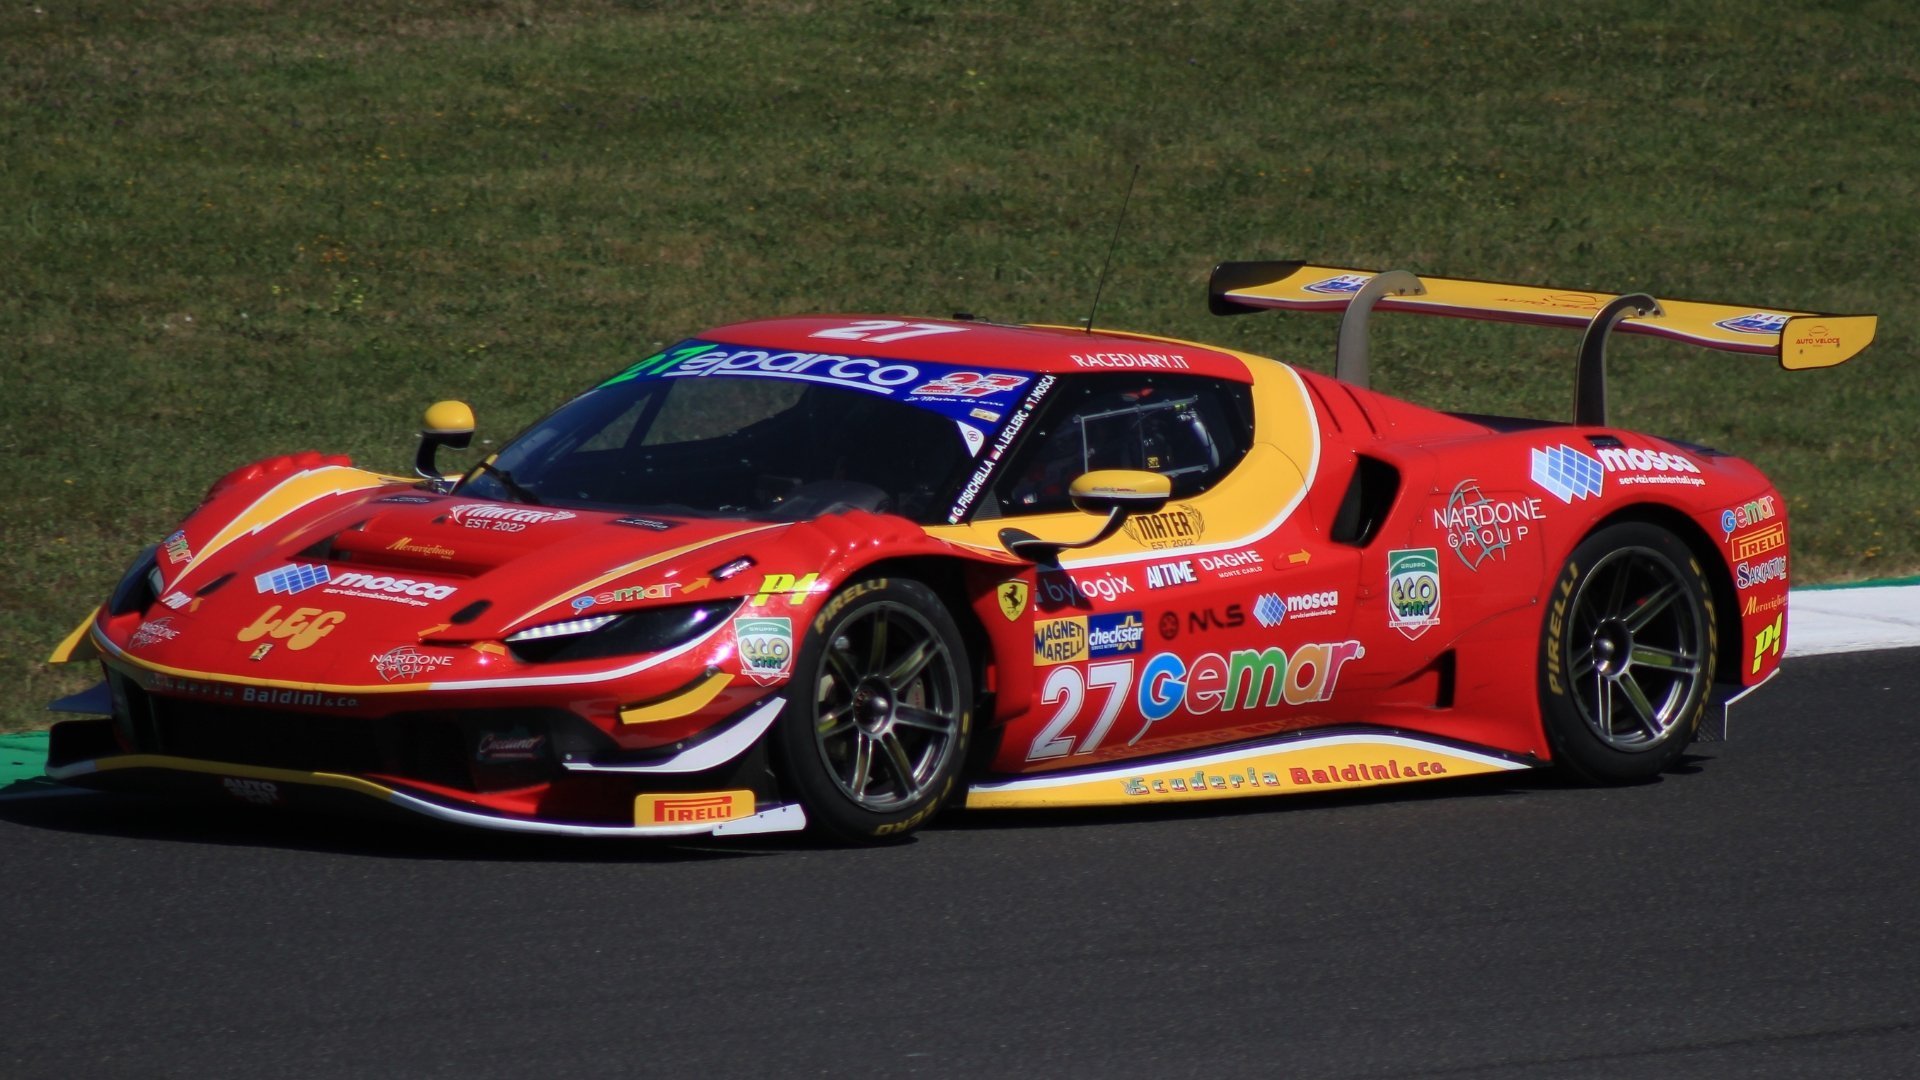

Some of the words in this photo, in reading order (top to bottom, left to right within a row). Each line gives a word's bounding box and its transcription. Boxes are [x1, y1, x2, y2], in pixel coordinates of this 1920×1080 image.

[808, 320, 971, 343] 27
[1815, 337, 1840, 345] VELOCE
[679, 351, 919, 386] sparco
[1070, 354, 1190, 369] RACEDIARY.IT
[997, 410, 1029, 453] A.LECLERC
[1597, 448, 1701, 473] mosca
[951, 460, 996, 516] G.FISICHELLA
[465, 518, 490, 530] EST.
[492, 521, 526, 533] 2022
[1135, 511, 1194, 540] MATER
[1433, 499, 1546, 529] NARDONE
[386, 537, 455, 556] Meraviglioso
[1151, 540, 1171, 550] EST.
[1173, 538, 1195, 548] 2022
[1448, 526, 1529, 548] GROUP
[1732, 522, 1785, 562] PIRELLI
[1199, 550, 1264, 572] DAGHE
[1218, 569, 1242, 579] MONTE
[1243, 566, 1263, 575] CARLO
[329, 572, 458, 600] mosca
[750, 573, 822, 606] P1
[1043, 572, 1135, 606] bylogix
[814, 578, 888, 634] PIRELLI
[1288, 591, 1338, 612] mosca
[1035, 620, 1084, 646] MAGNETI
[1089, 625, 1144, 647] checkstar
[1547, 561, 1579, 696] PIRELLI
[1035, 638, 1084, 661] MARELLI
[1752, 612, 1782, 674] P1
[370, 654, 454, 666] NARDONE
[376, 663, 436, 673] GROUP
[1138, 641, 1361, 722] Gemar
[243, 687, 322, 707] Baldini
[1025, 658, 1134, 762] 27
[1127, 767, 1281, 795] Scuderia
[1289, 760, 1401, 785] Baldini
[654, 796, 732, 822] PIRELLI
